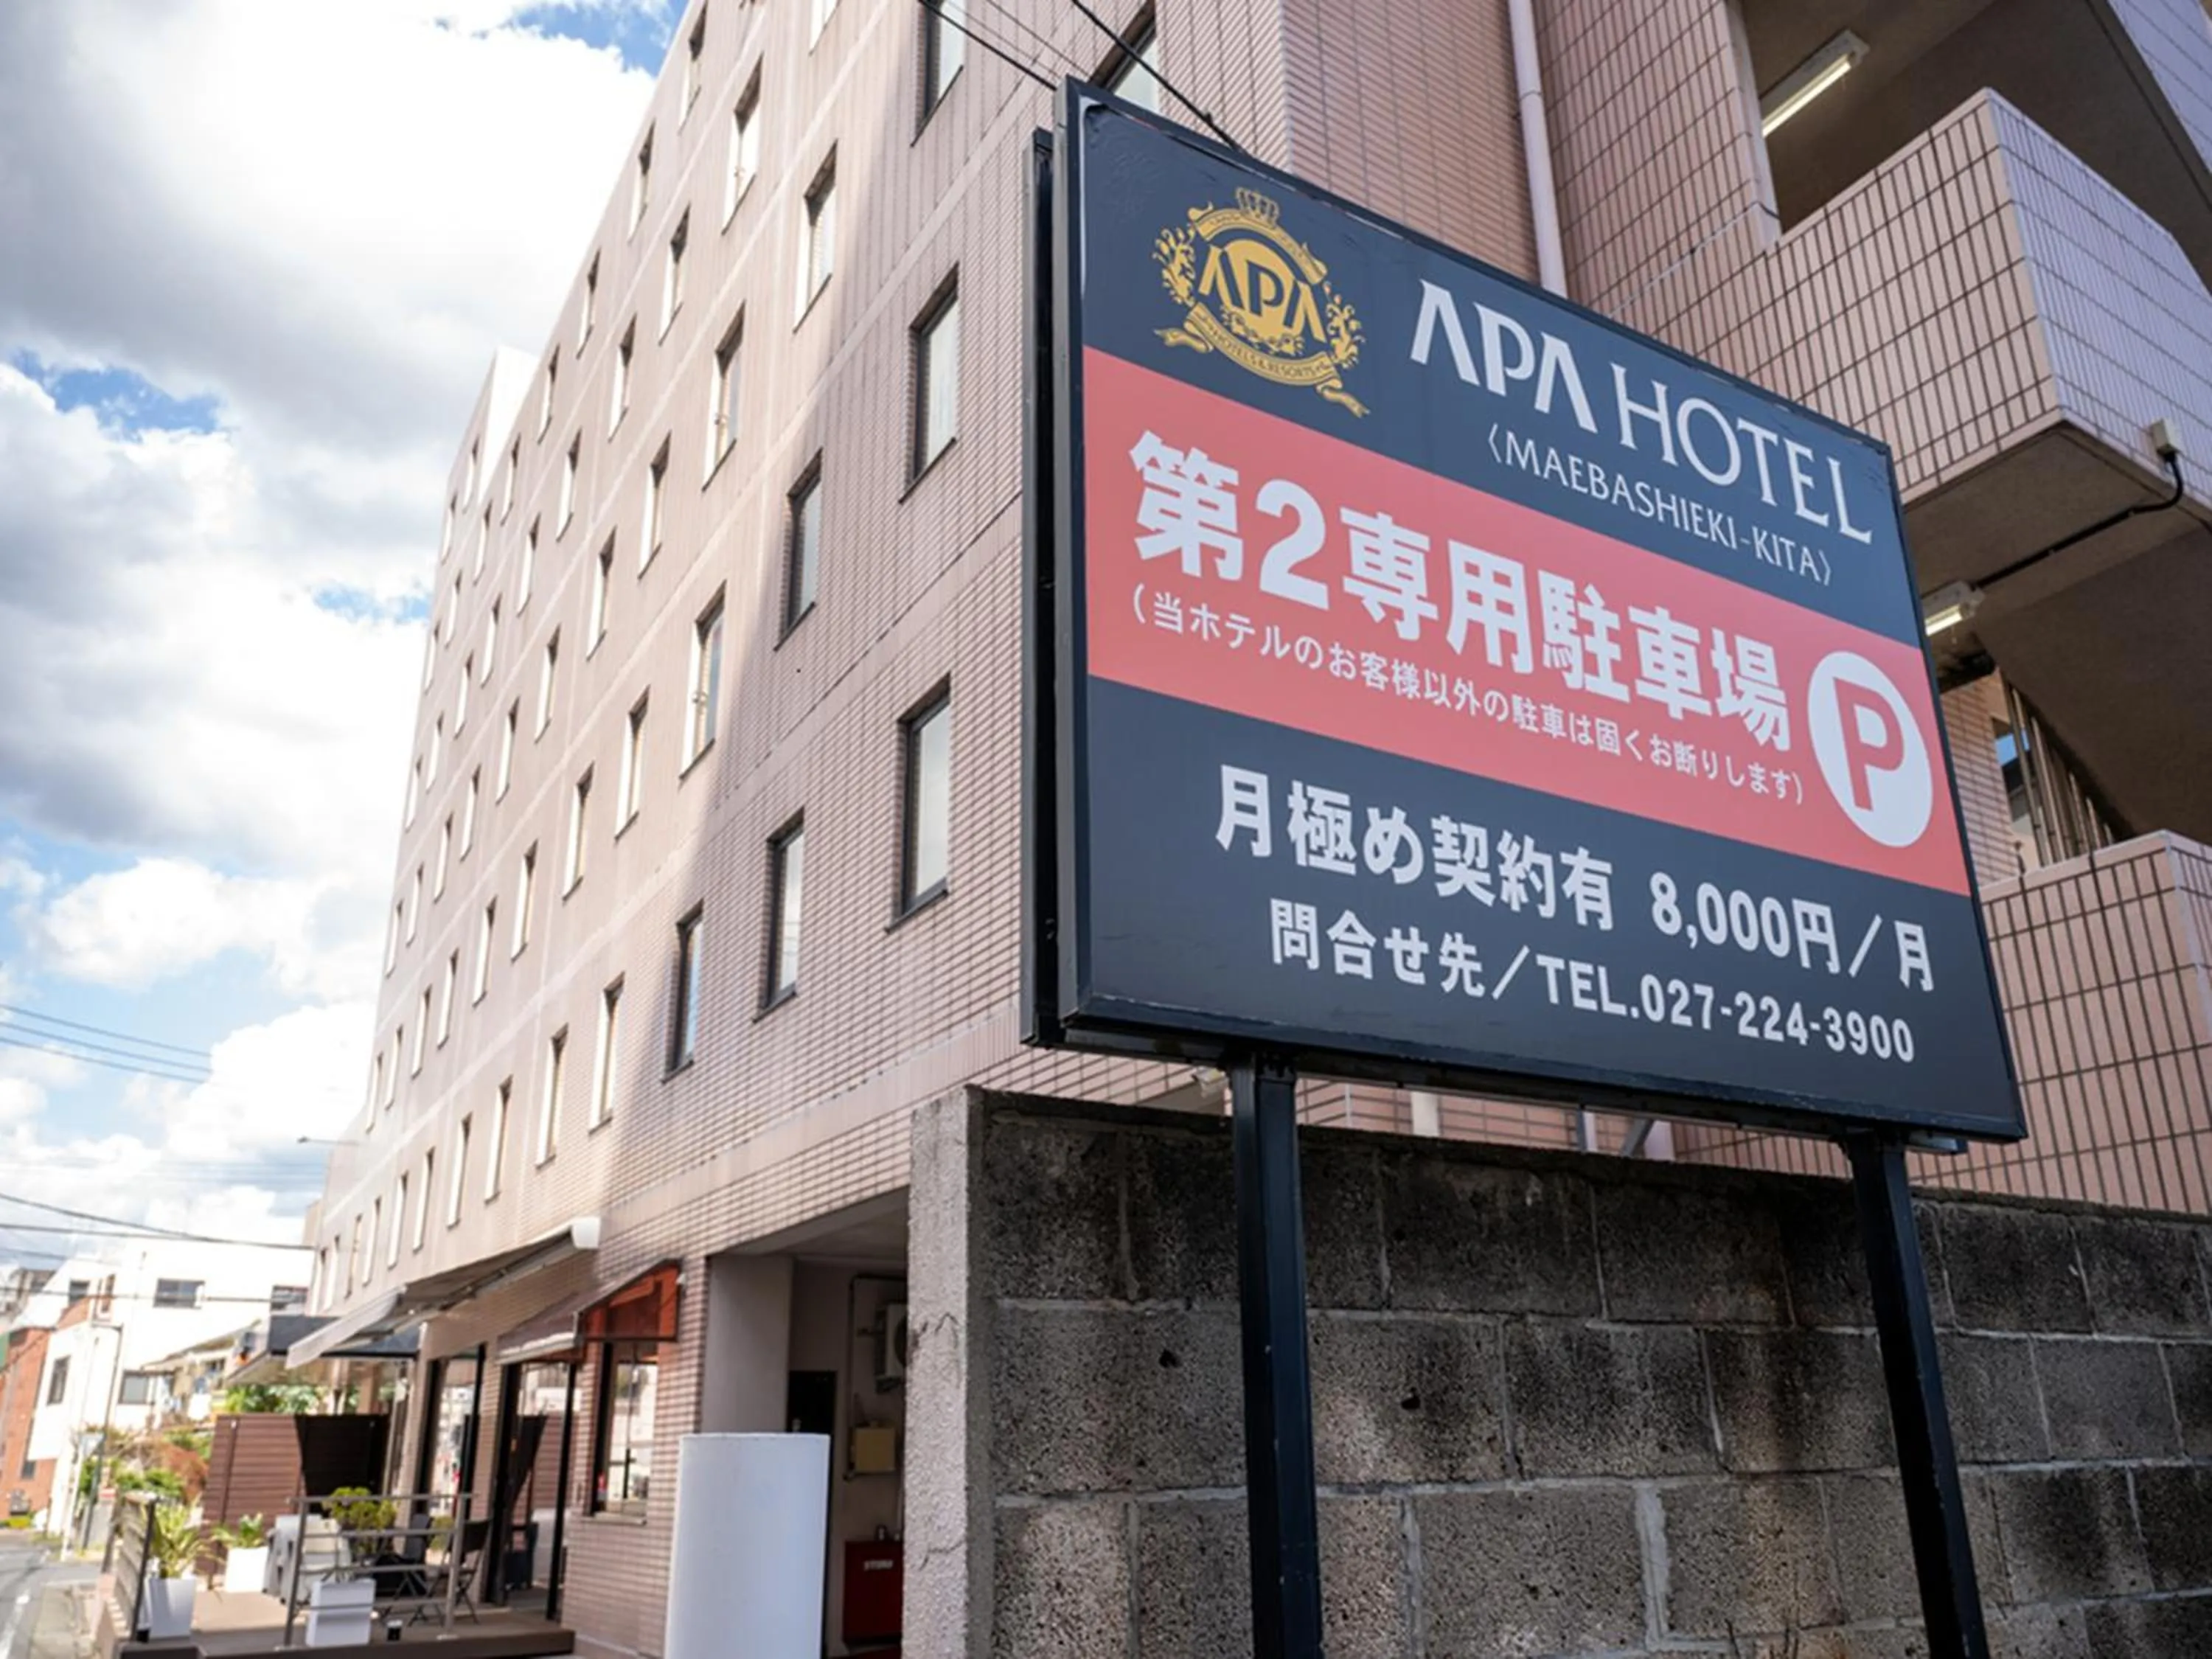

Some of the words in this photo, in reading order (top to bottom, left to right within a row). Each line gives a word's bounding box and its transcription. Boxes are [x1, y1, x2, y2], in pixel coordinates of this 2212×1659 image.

[1197, 243, 1326, 344] APA
[1410, 279, 1597, 434] APA
[1610, 363, 1872, 544] HOTEL
[1129, 430, 1790, 751] 第2専用駐車場
[1832, 676, 1905, 812] P
[1215, 764, 1613, 931] 月極め契約有
